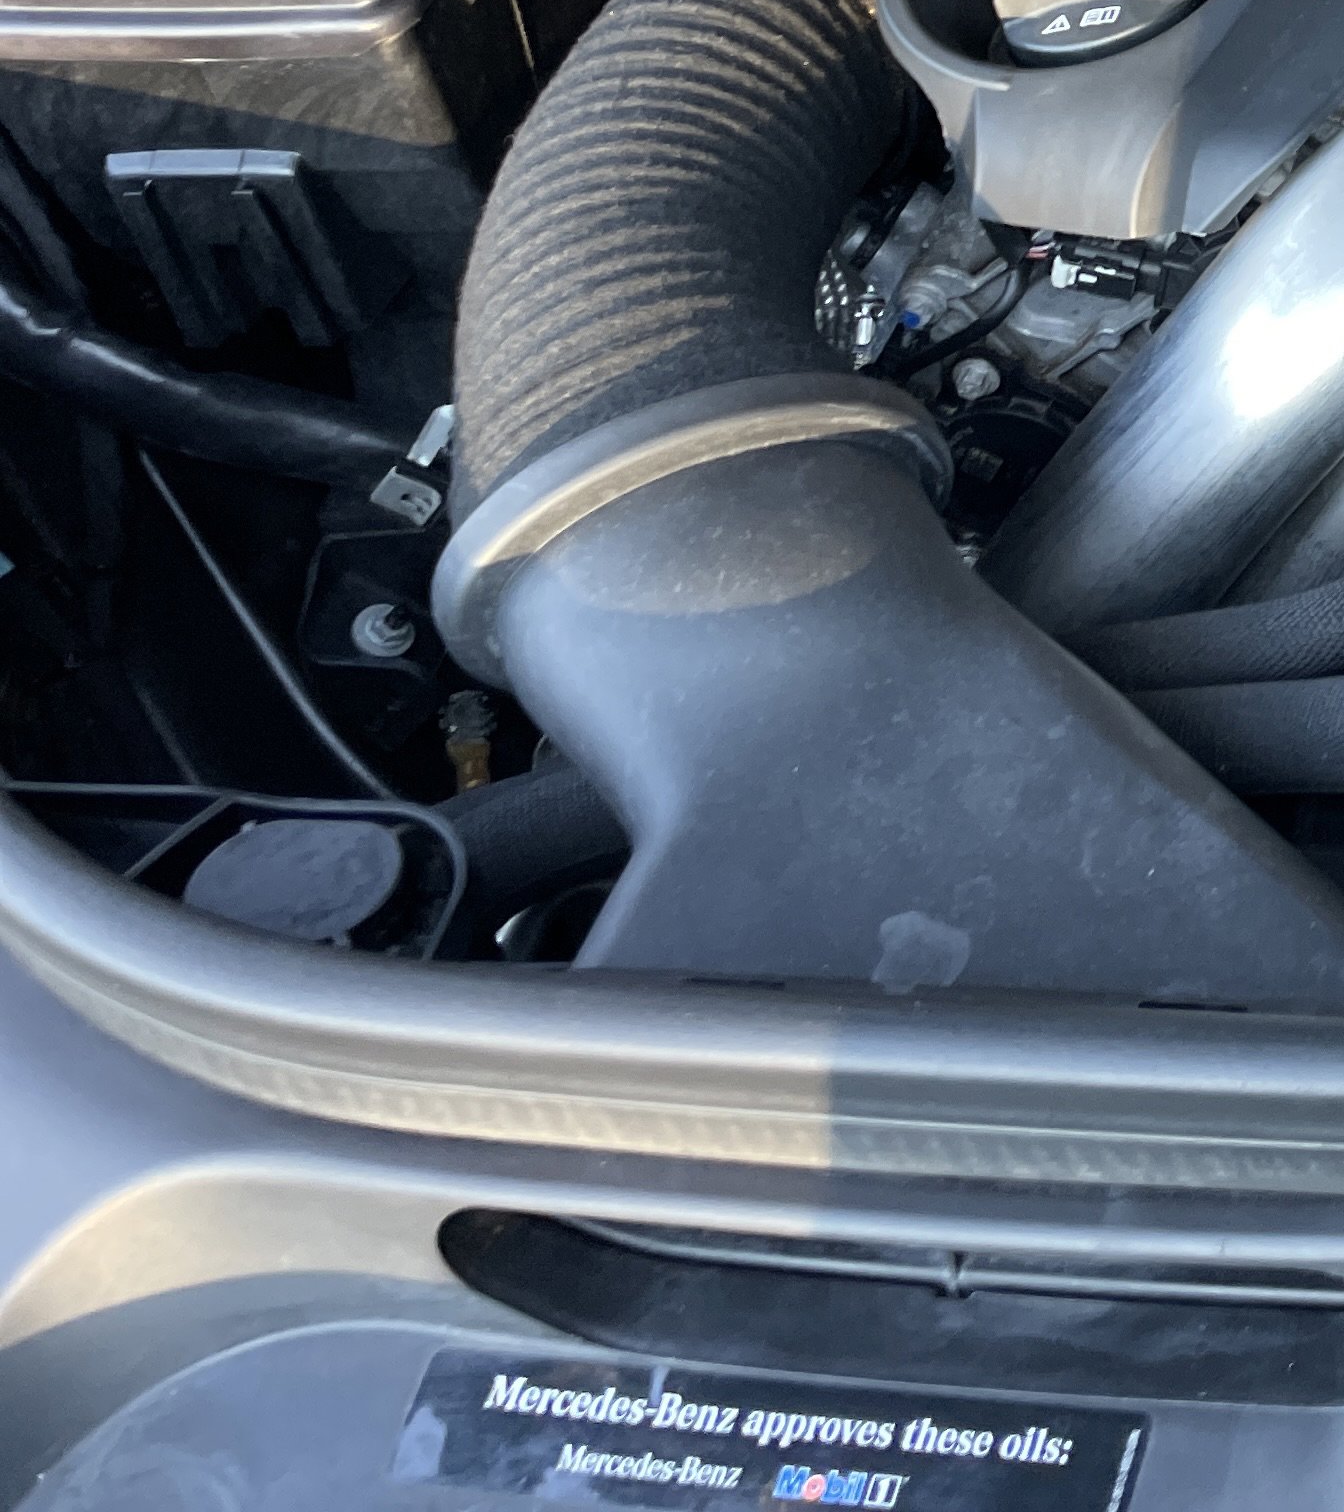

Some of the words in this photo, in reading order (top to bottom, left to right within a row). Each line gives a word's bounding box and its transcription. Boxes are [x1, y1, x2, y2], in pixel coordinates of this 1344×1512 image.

[483, 1374, 739, 1435] Mercedes-Benz
[742, 1408, 896, 1449] approves
[901, 1417, 994, 1459] these
[999, 1426, 1074, 1467] oils:
[555, 1443, 743, 1489] Mercedes-Benz
